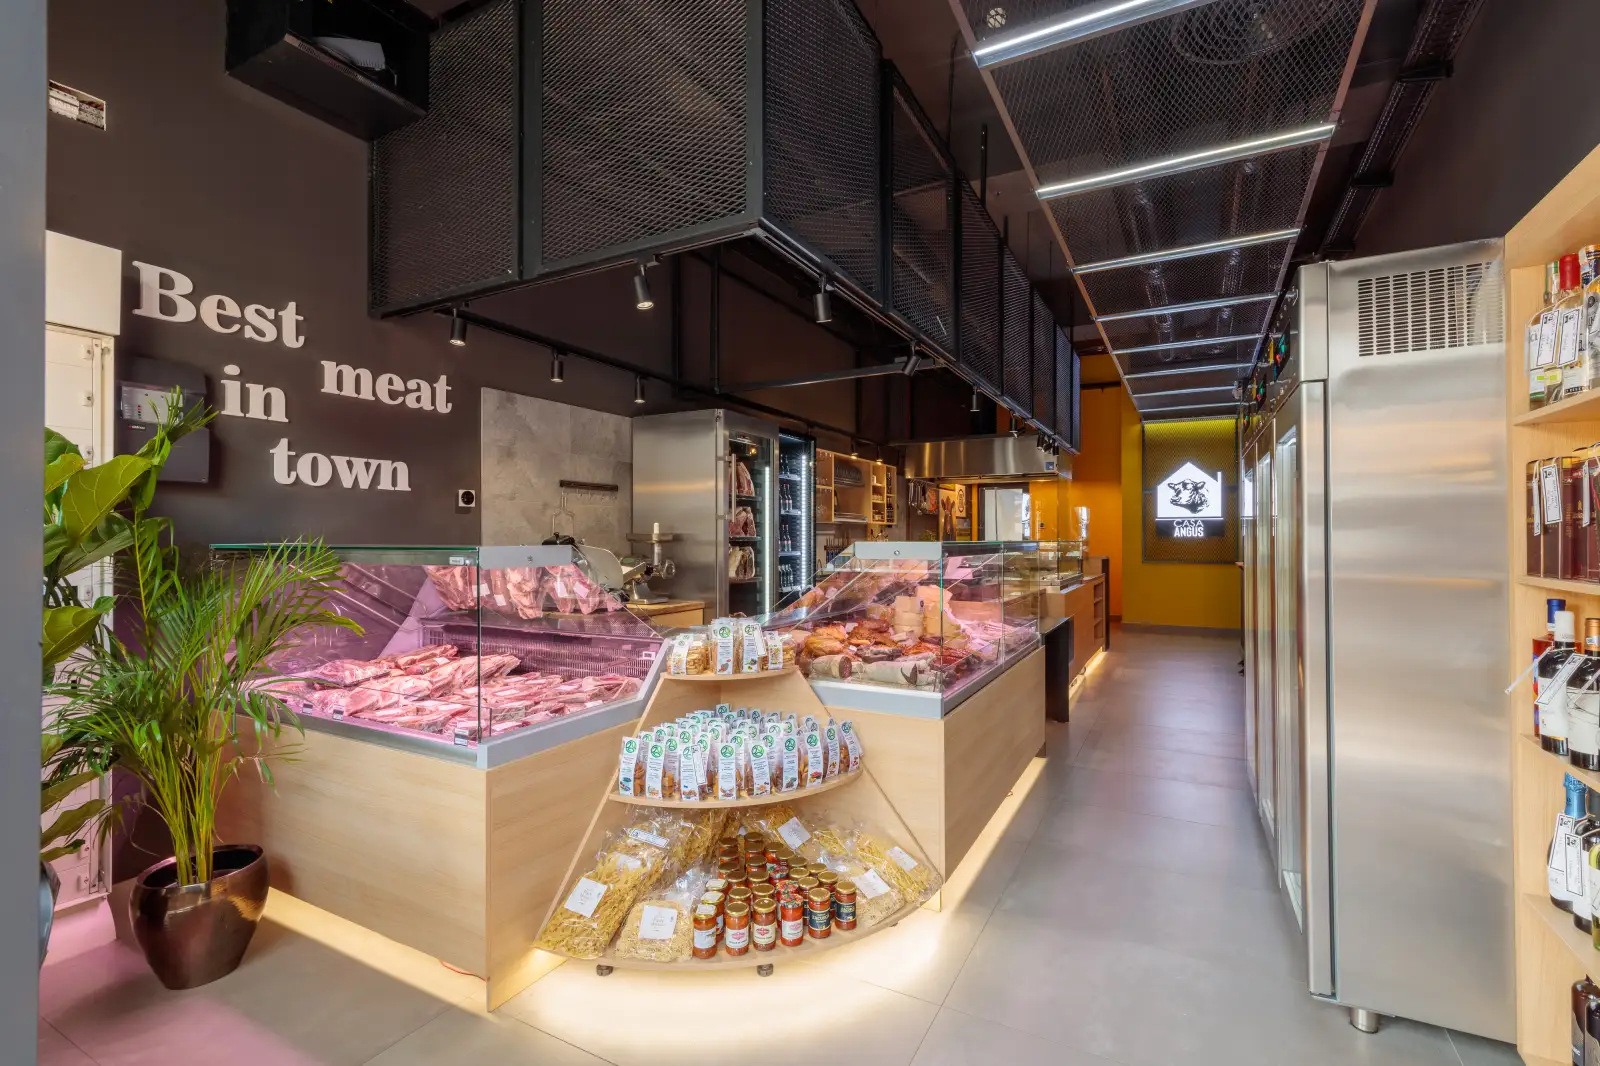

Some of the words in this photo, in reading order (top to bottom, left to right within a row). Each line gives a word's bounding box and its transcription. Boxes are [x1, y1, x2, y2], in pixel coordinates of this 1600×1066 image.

[132, 260, 305, 348] Best
[220, 364, 289, 423] in
[320, 360, 452, 414] meat
[269, 438, 411, 491] town
[1173, 519, 1204, 527] CASA
[1173, 526, 1204, 537] ANGUS
